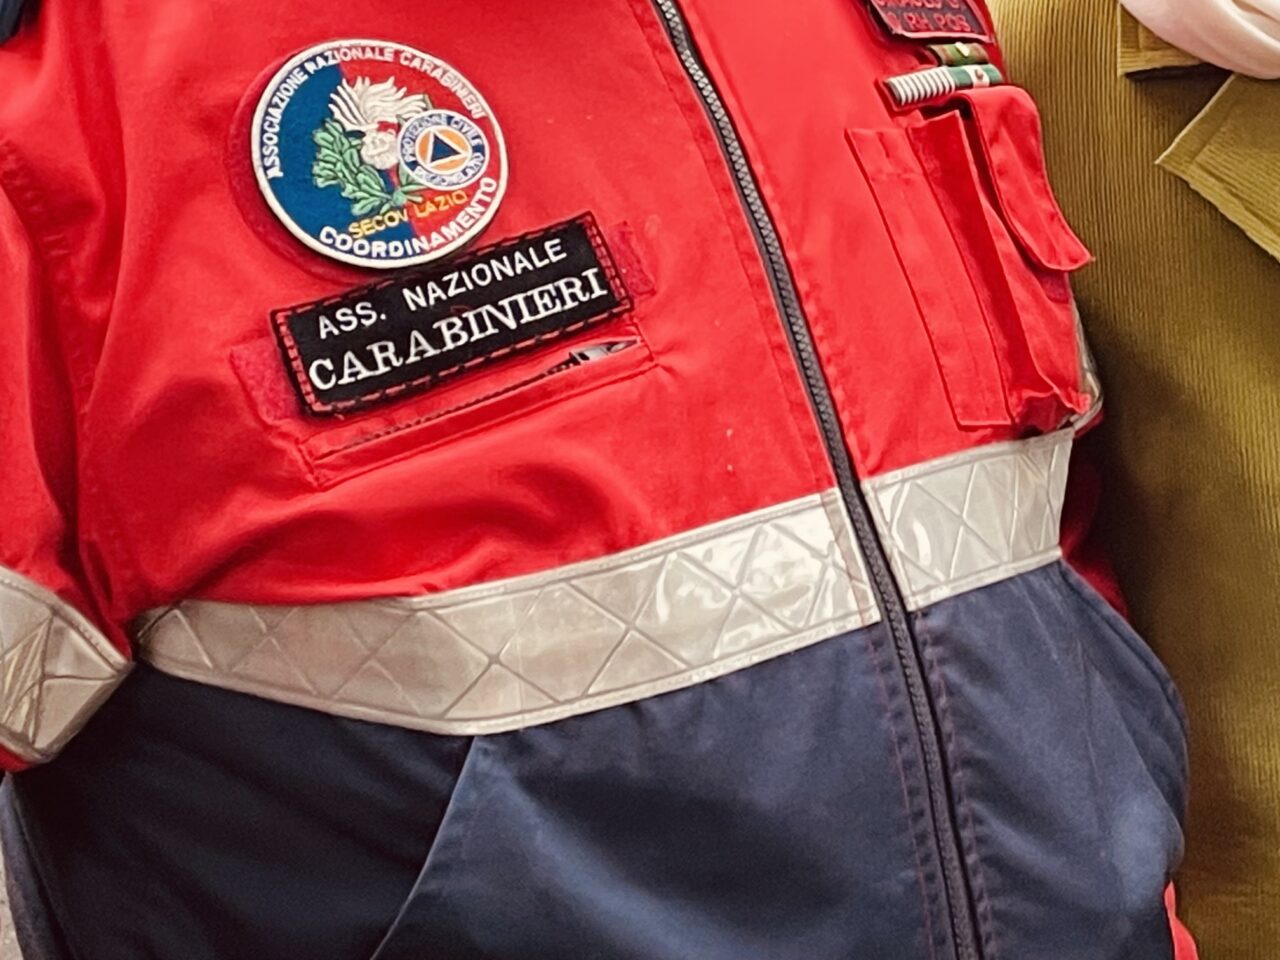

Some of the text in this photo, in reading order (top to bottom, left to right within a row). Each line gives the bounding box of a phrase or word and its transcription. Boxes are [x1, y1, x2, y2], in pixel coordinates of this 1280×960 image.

[263, 46, 488, 180] ASSOCIAZIONE NAZIONALE CARABINIERI
[450, 117, 483, 146] CIVILE
[319, 177, 498, 259] COORDINAMENTO
[348, 190, 469, 239] SECOV LAZIO
[308, 268, 608, 391] CARABINIERI
[318, 238, 567, 340] ASS. NAZIONALE
